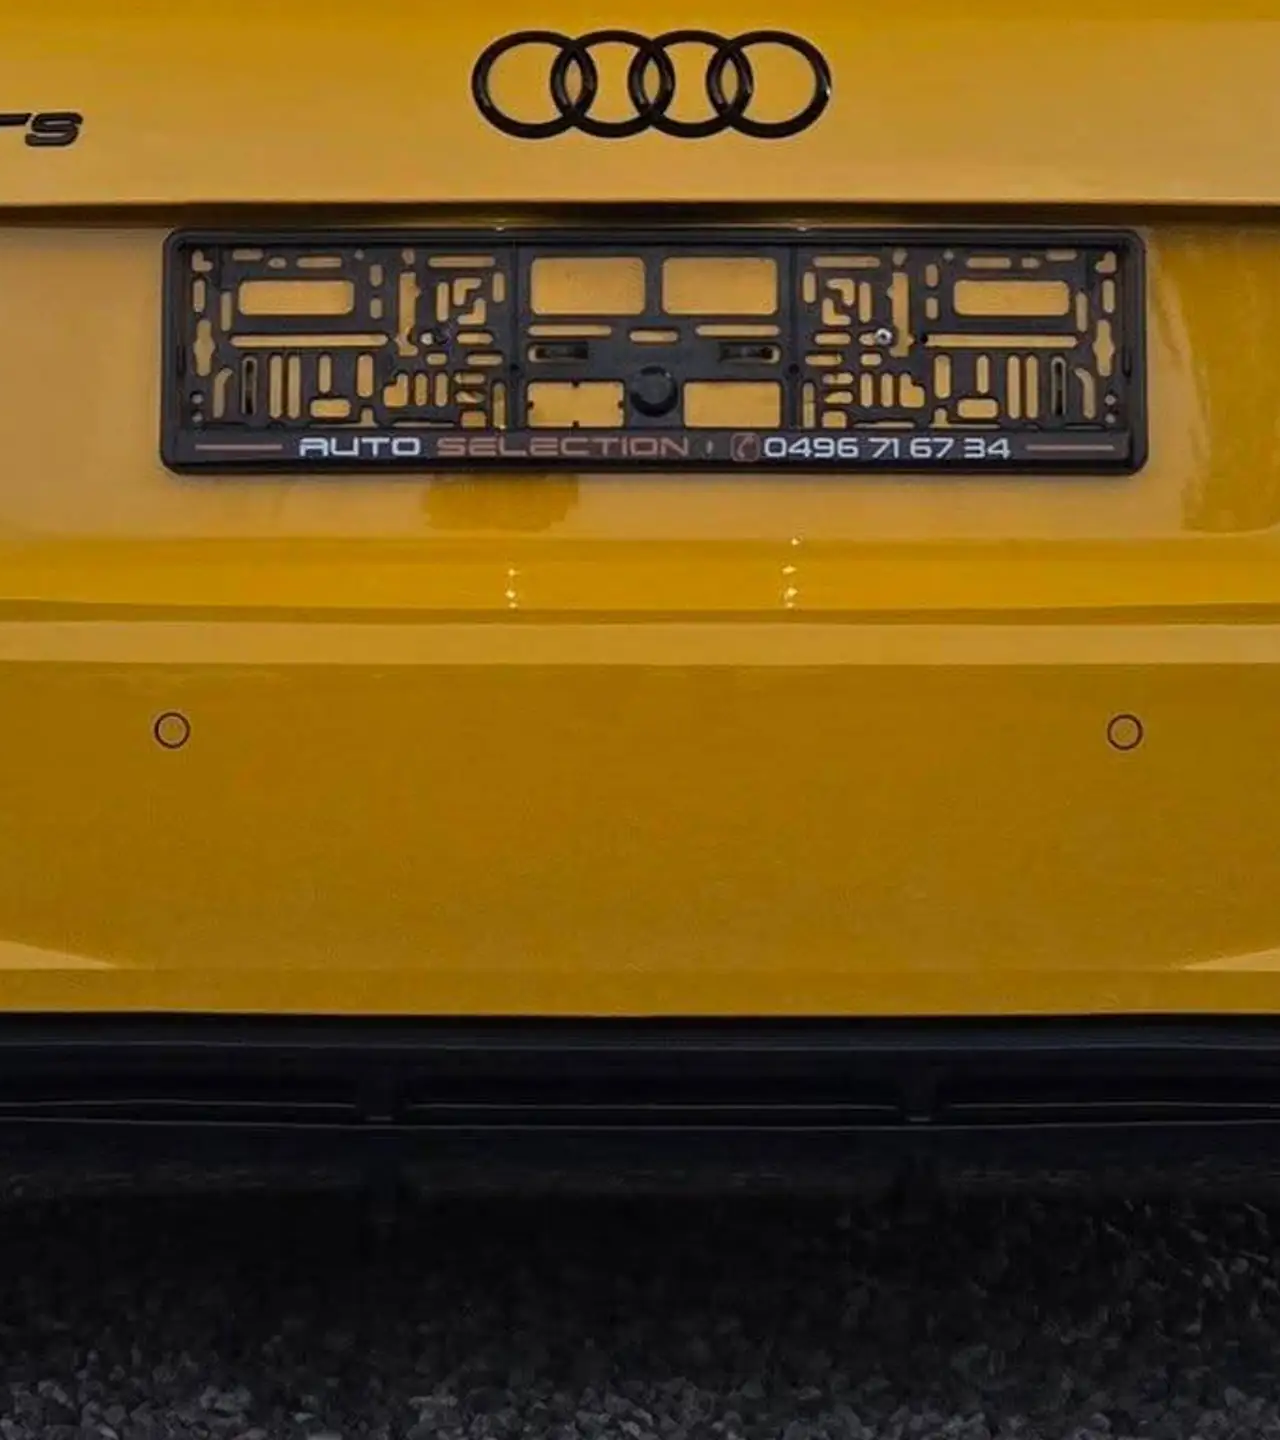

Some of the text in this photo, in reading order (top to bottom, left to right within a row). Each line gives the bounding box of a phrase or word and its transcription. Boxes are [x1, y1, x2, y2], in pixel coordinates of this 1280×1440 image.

[298, 436, 1012, 459] AUTO SELECTION 0496 71 67 34
